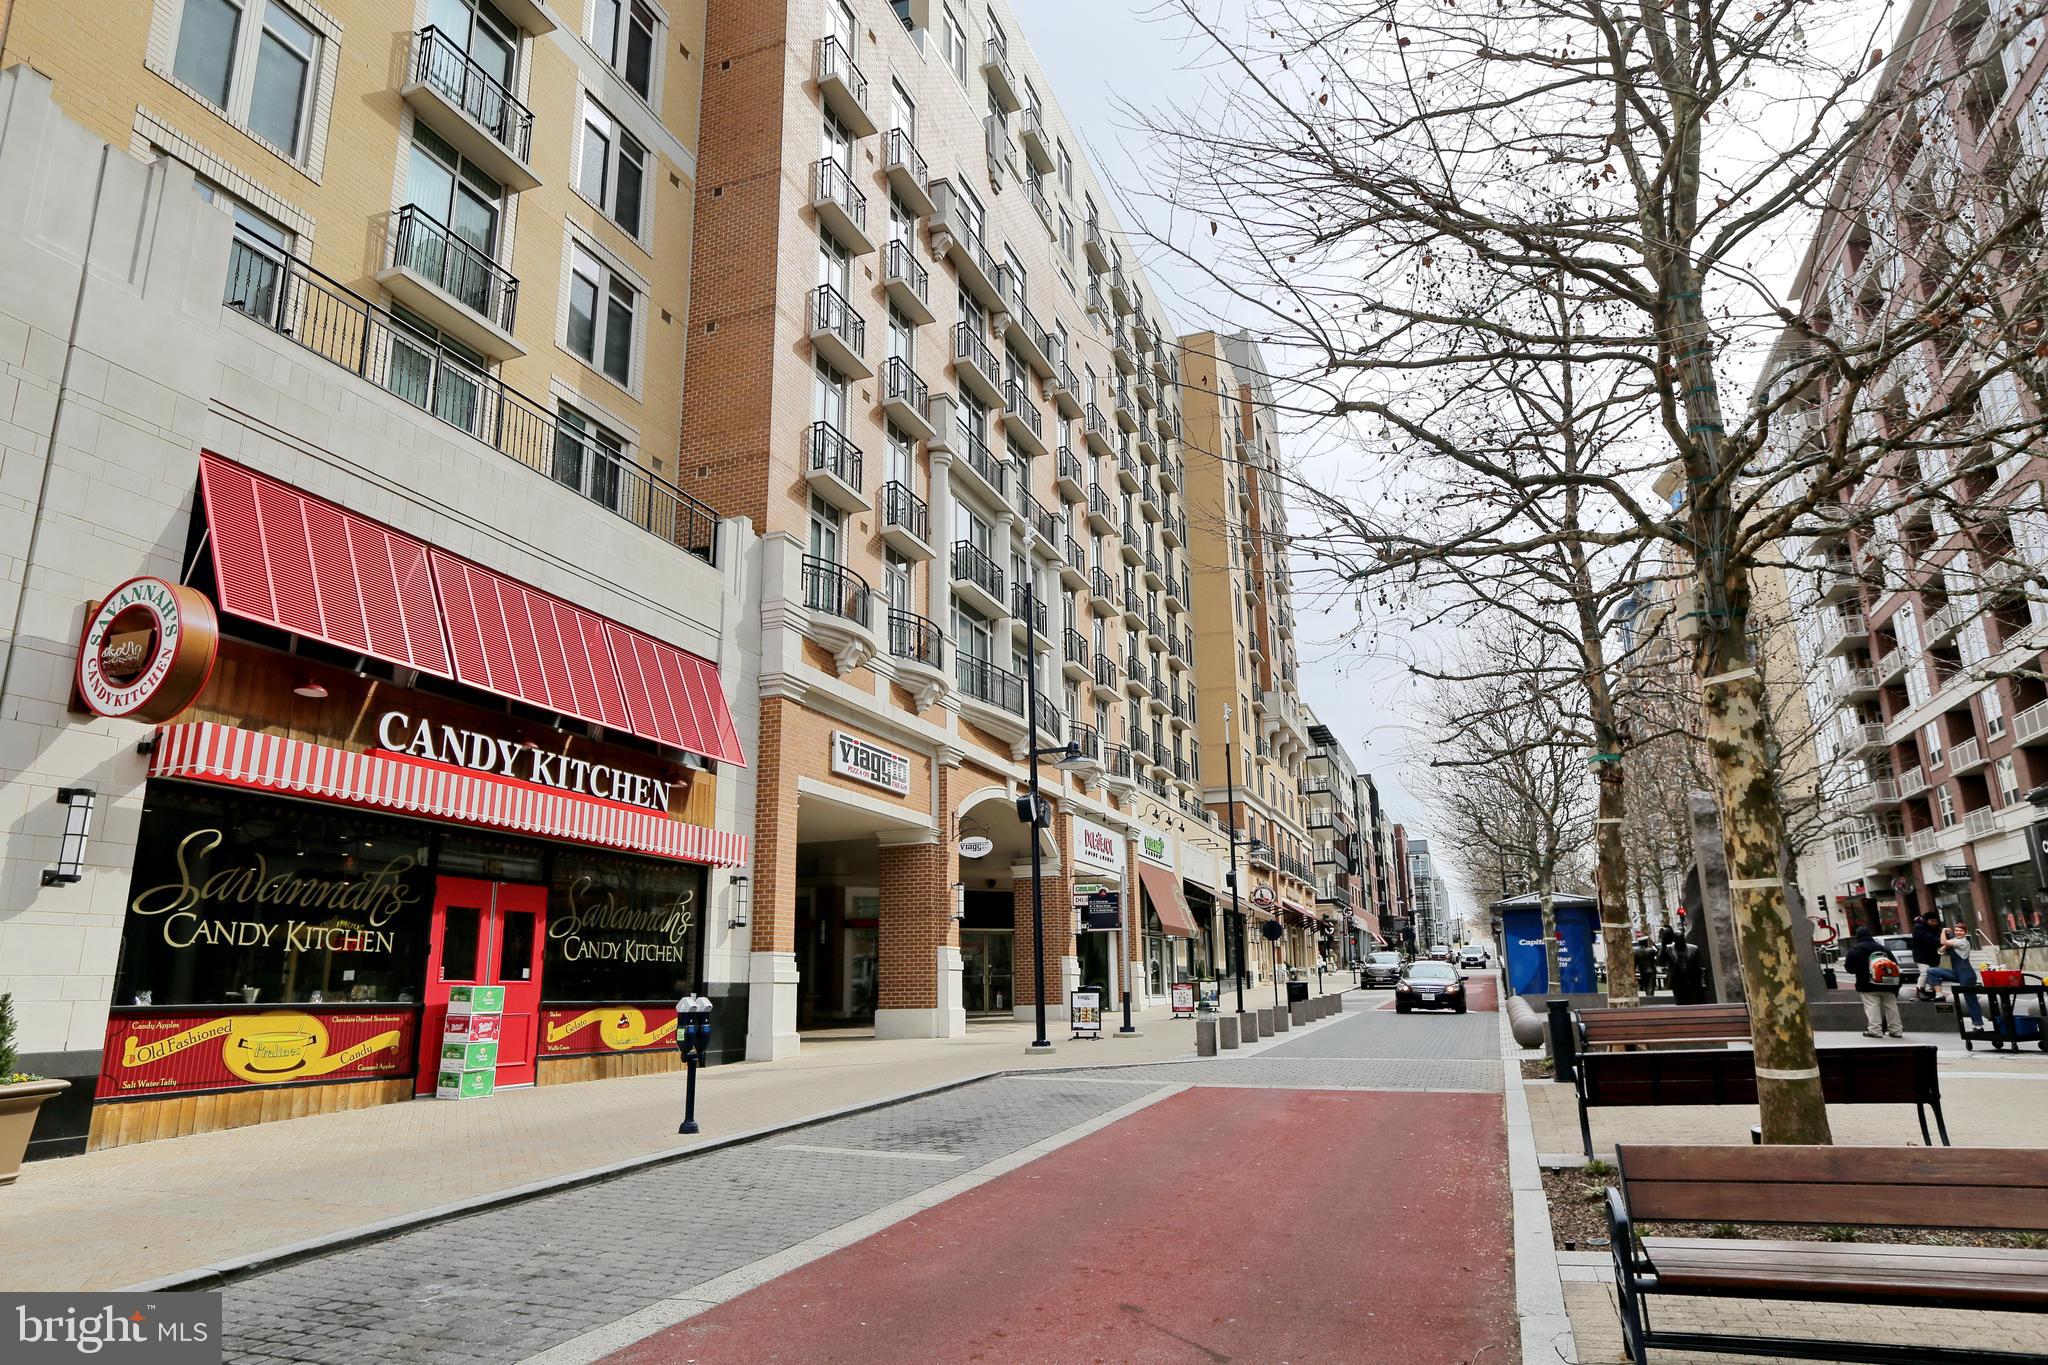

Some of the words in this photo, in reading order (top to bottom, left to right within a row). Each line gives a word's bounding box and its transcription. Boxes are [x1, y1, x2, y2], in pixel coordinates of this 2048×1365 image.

[90, 584, 178, 646] SAVANNAH'S
[379, 711, 523, 777] CANDY
[529, 748, 671, 812] KITCHEN
[848, 765, 862, 776] PIZZA
[132, 828, 421, 927] Savannah's
[549, 876, 695, 944] Savannah's
[163, 912, 279, 948] CANDY
[284, 920, 395, 954] KITCHEN
[564, 935, 622, 961] CANDY
[624, 939, 684, 963] KITCHEN
[132, 1021, 155, 1031] Candy
[156, 1021, 180, 1030] Apples
[137, 1042, 165, 1062] Old
[168, 1019, 232, 1053] Fashioned
[565, 1019, 588, 1034] Gelato
[340, 1043, 373, 1064] Candy
[122, 1080, 136, 1089] Salt
[137, 1079, 159, 1088] Water
[160, 1077, 177, 1087] Taffy
